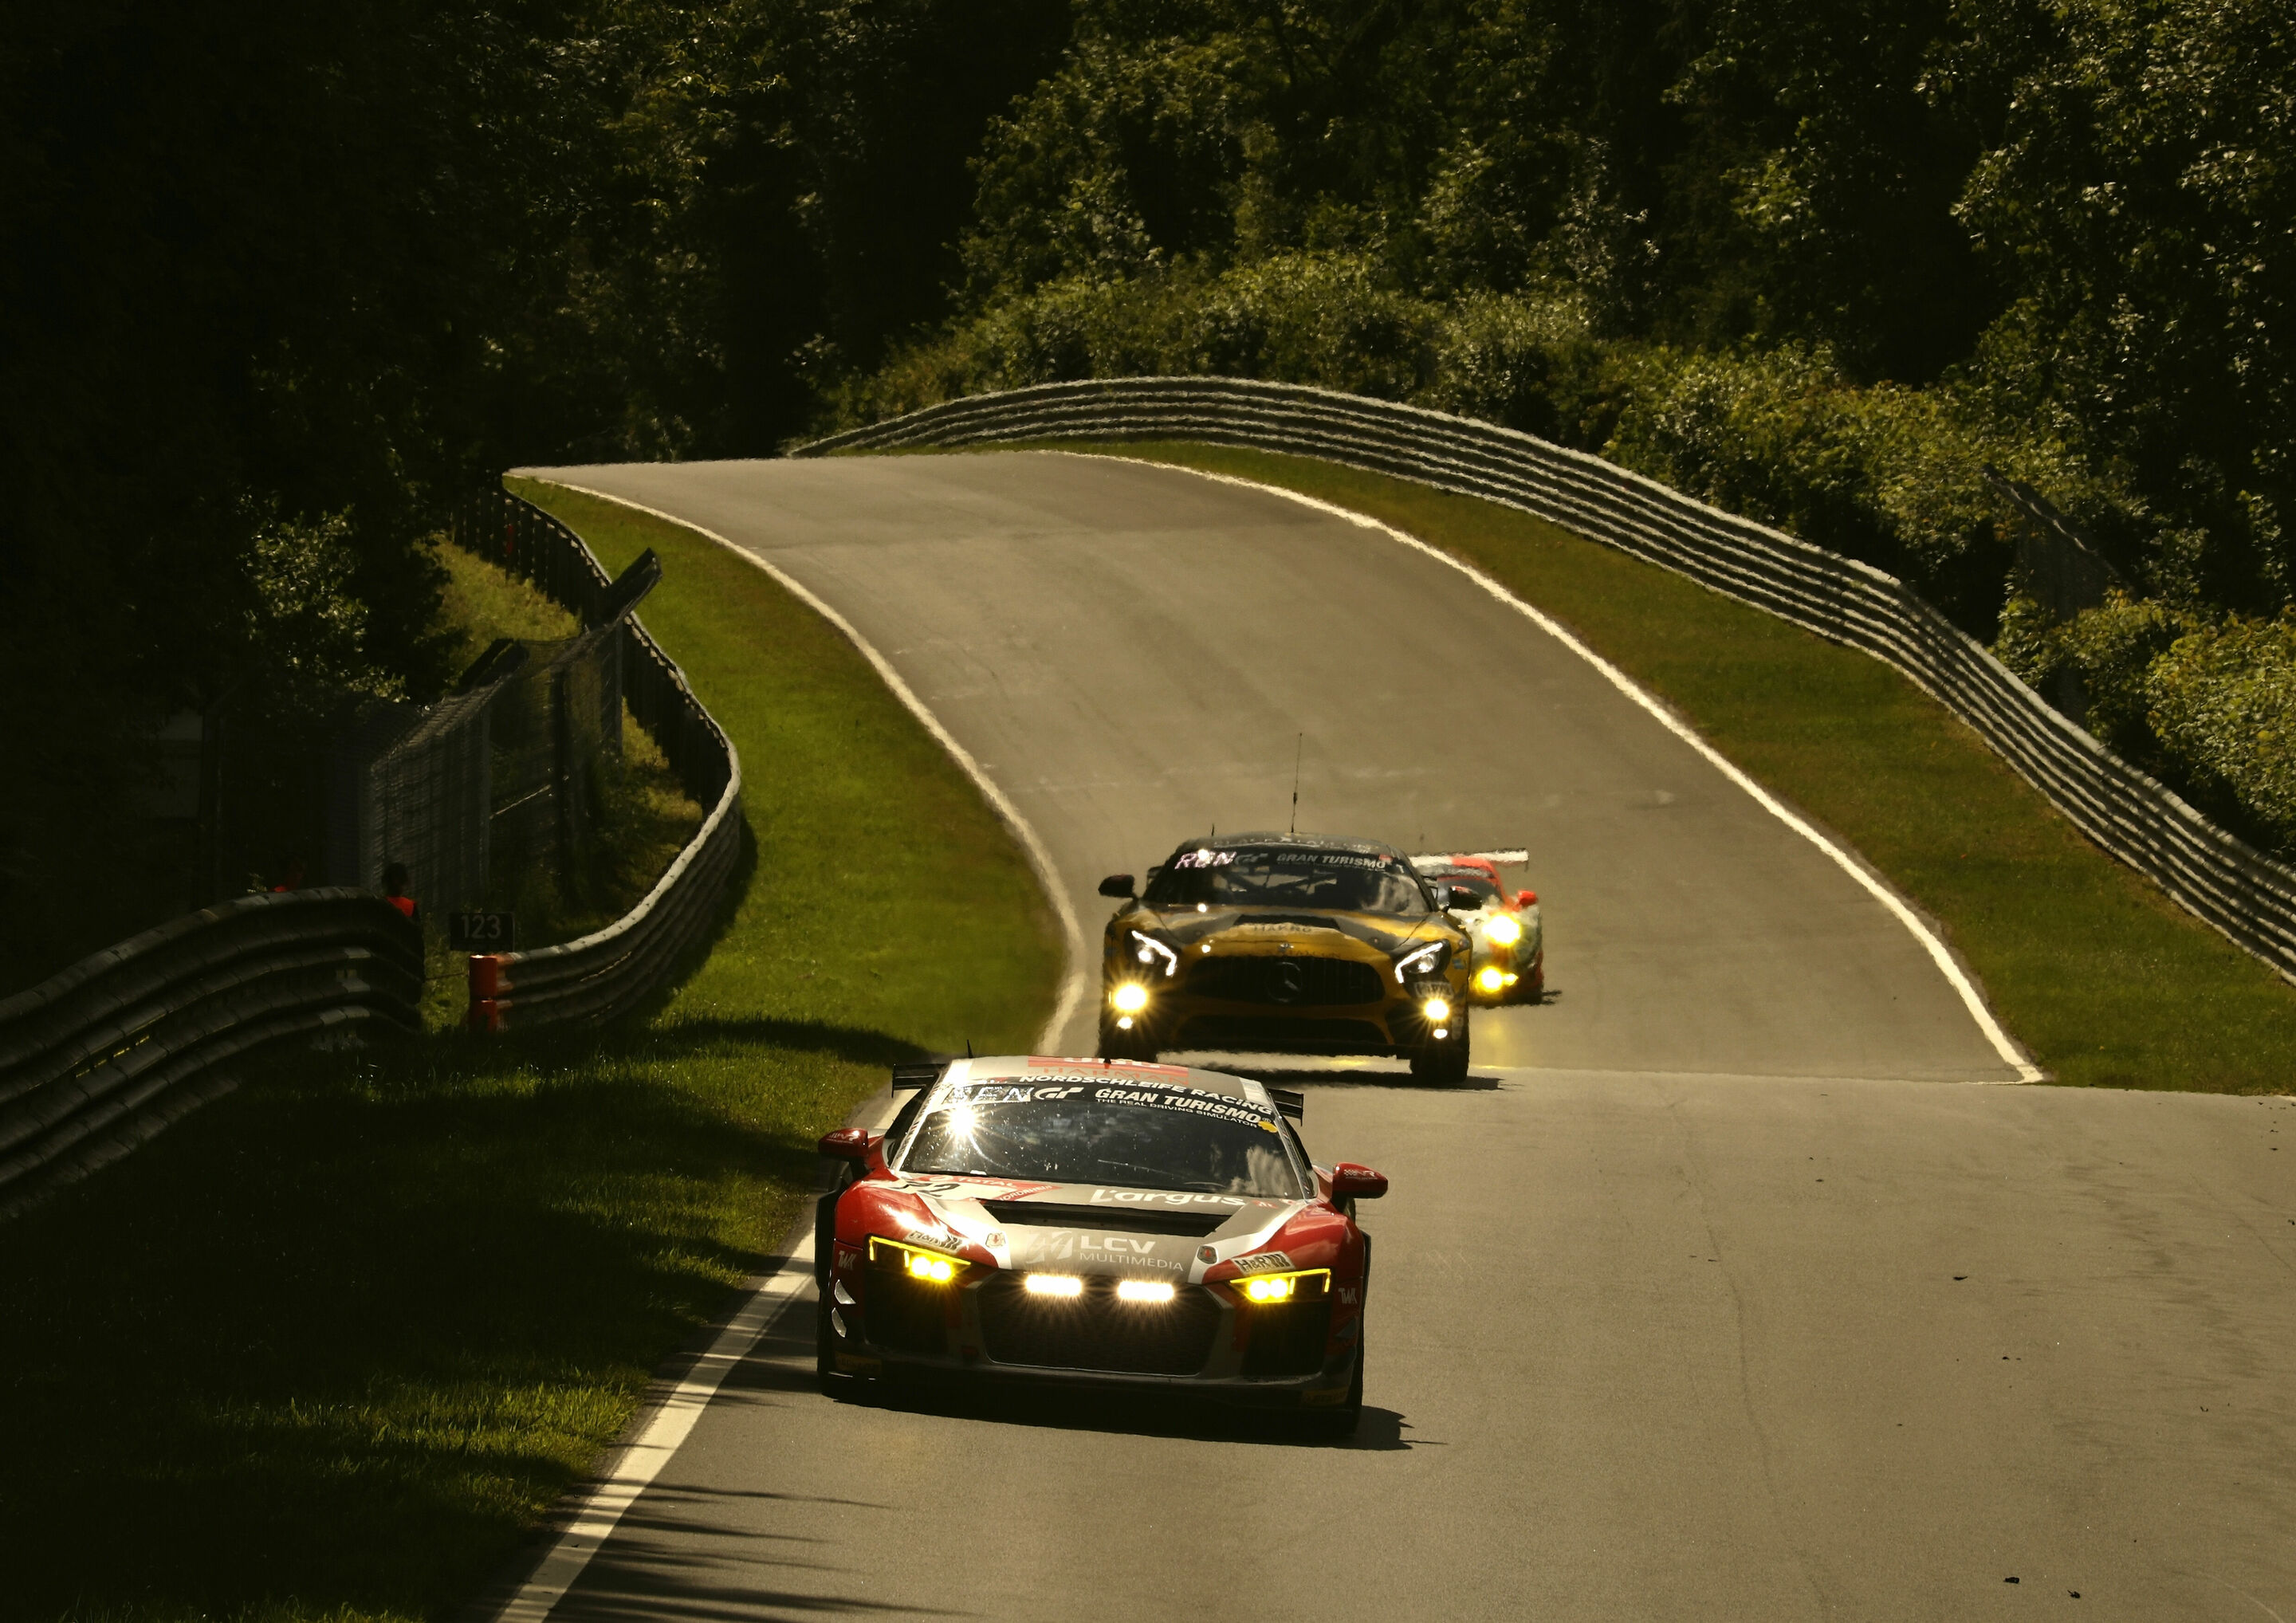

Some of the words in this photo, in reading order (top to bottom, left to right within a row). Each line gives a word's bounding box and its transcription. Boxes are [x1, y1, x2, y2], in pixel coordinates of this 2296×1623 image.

[1276, 853, 1318, 863] GRAN
[1322, 855, 1386, 869] TURISMO
[461, 914, 501, 939] 123
[1043, 1067, 1189, 1086] HARMAN
[1019, 1074, 1187, 1093] NORDSCHLEIFE
[1190, 1088, 1273, 1115] RACING
[1095, 1087, 1158, 1103] GRAN
[1117, 1098, 1147, 1107] REAL
[1149, 1102, 1194, 1114] DRIVING
[1196, 1110, 1258, 1129] SIMULATOR
[957, 1176, 1017, 1188] TOTAL
[1089, 1189, 1246, 1206] L'argus
[1080, 1235, 1156, 1255] LCV
[1079, 1252, 1185, 1272] MULTIMEDIA
[1235, 1255, 1268, 1272] H&R
